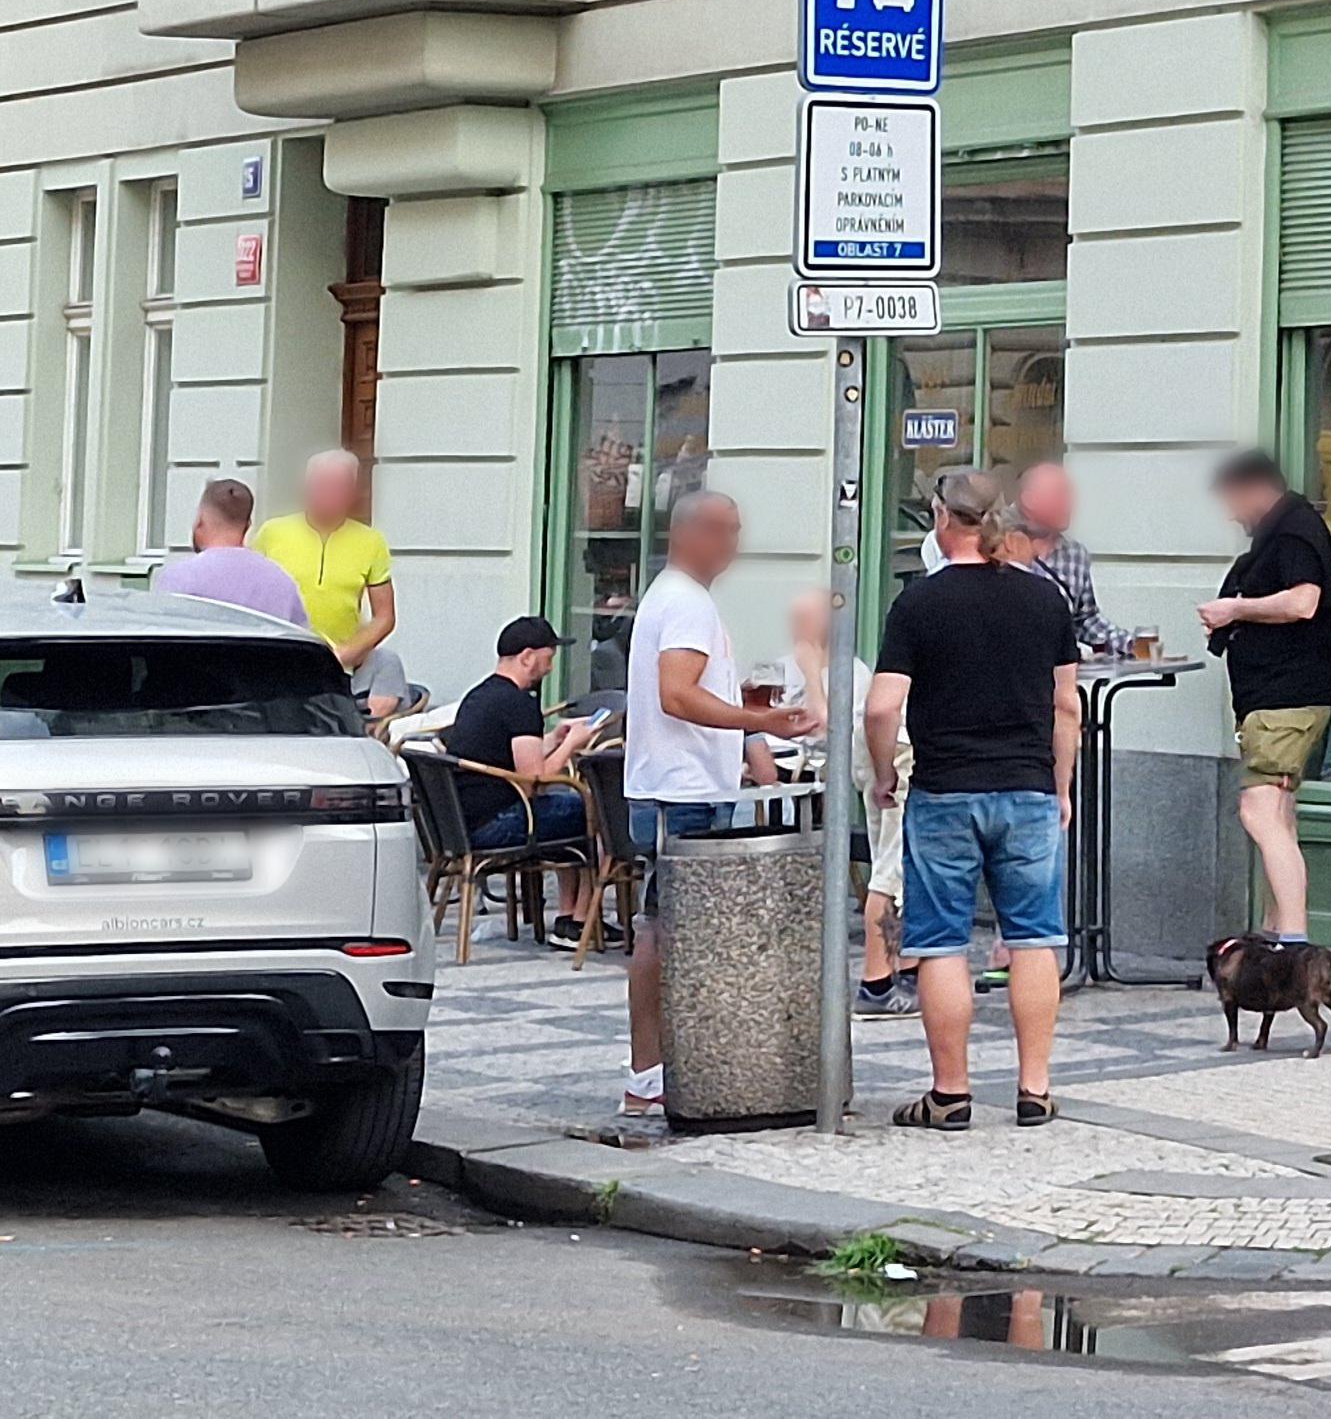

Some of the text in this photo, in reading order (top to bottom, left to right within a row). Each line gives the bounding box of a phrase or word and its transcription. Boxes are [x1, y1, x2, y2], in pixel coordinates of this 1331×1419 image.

[819, 23, 927, 61] RÉSERVÉ
[854, 116, 888, 132] PO-NE
[848, 141, 893, 157] 08-06 h
[841, 164, 901, 182] S PLATNÝM
[837, 188, 903, 207] PARKOVACÍM
[836, 213, 904, 233] OPRÁVNĚNÍM
[837, 242, 902, 257] OBLAST 7
[843, 295, 918, 319] P7-0038
[172, 791, 303, 808] ROVER
[101, 916, 205, 932] albioncars.cz
